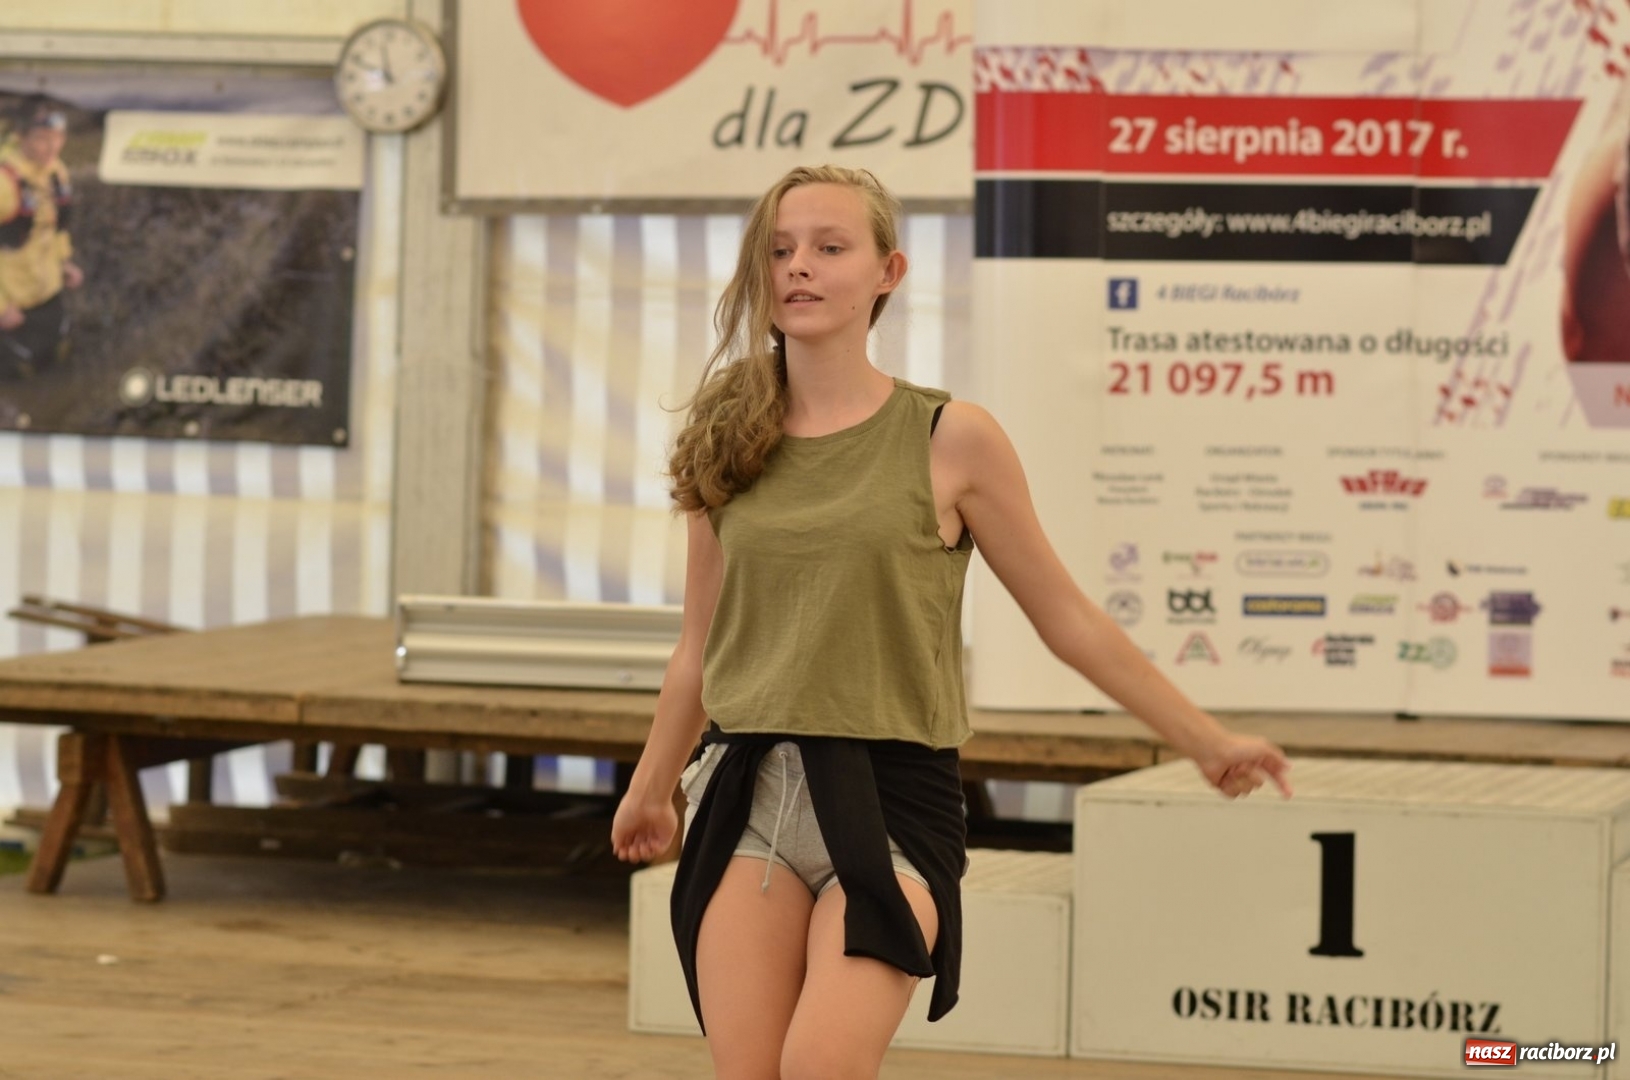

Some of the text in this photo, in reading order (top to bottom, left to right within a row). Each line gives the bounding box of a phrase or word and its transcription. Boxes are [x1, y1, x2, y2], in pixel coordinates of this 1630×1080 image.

[712, 78, 970, 150] dla ZD
[1108, 116, 1469, 163] 27 sierpnia 2017 r.
[1107, 207, 1492, 242] szczegóły: www.4biegiraciborz.pl
[1172, 285, 1218, 302] BIEGI
[1108, 327, 1509, 364] Trasa atestowana o długości
[155, 374, 324, 408] LEDLENSER
[1108, 361, 1334, 401] 21 097,5 m
[1308, 832, 1364, 957] 1
[1172, 986, 1502, 1034] OSIR RACIBÓRZ
